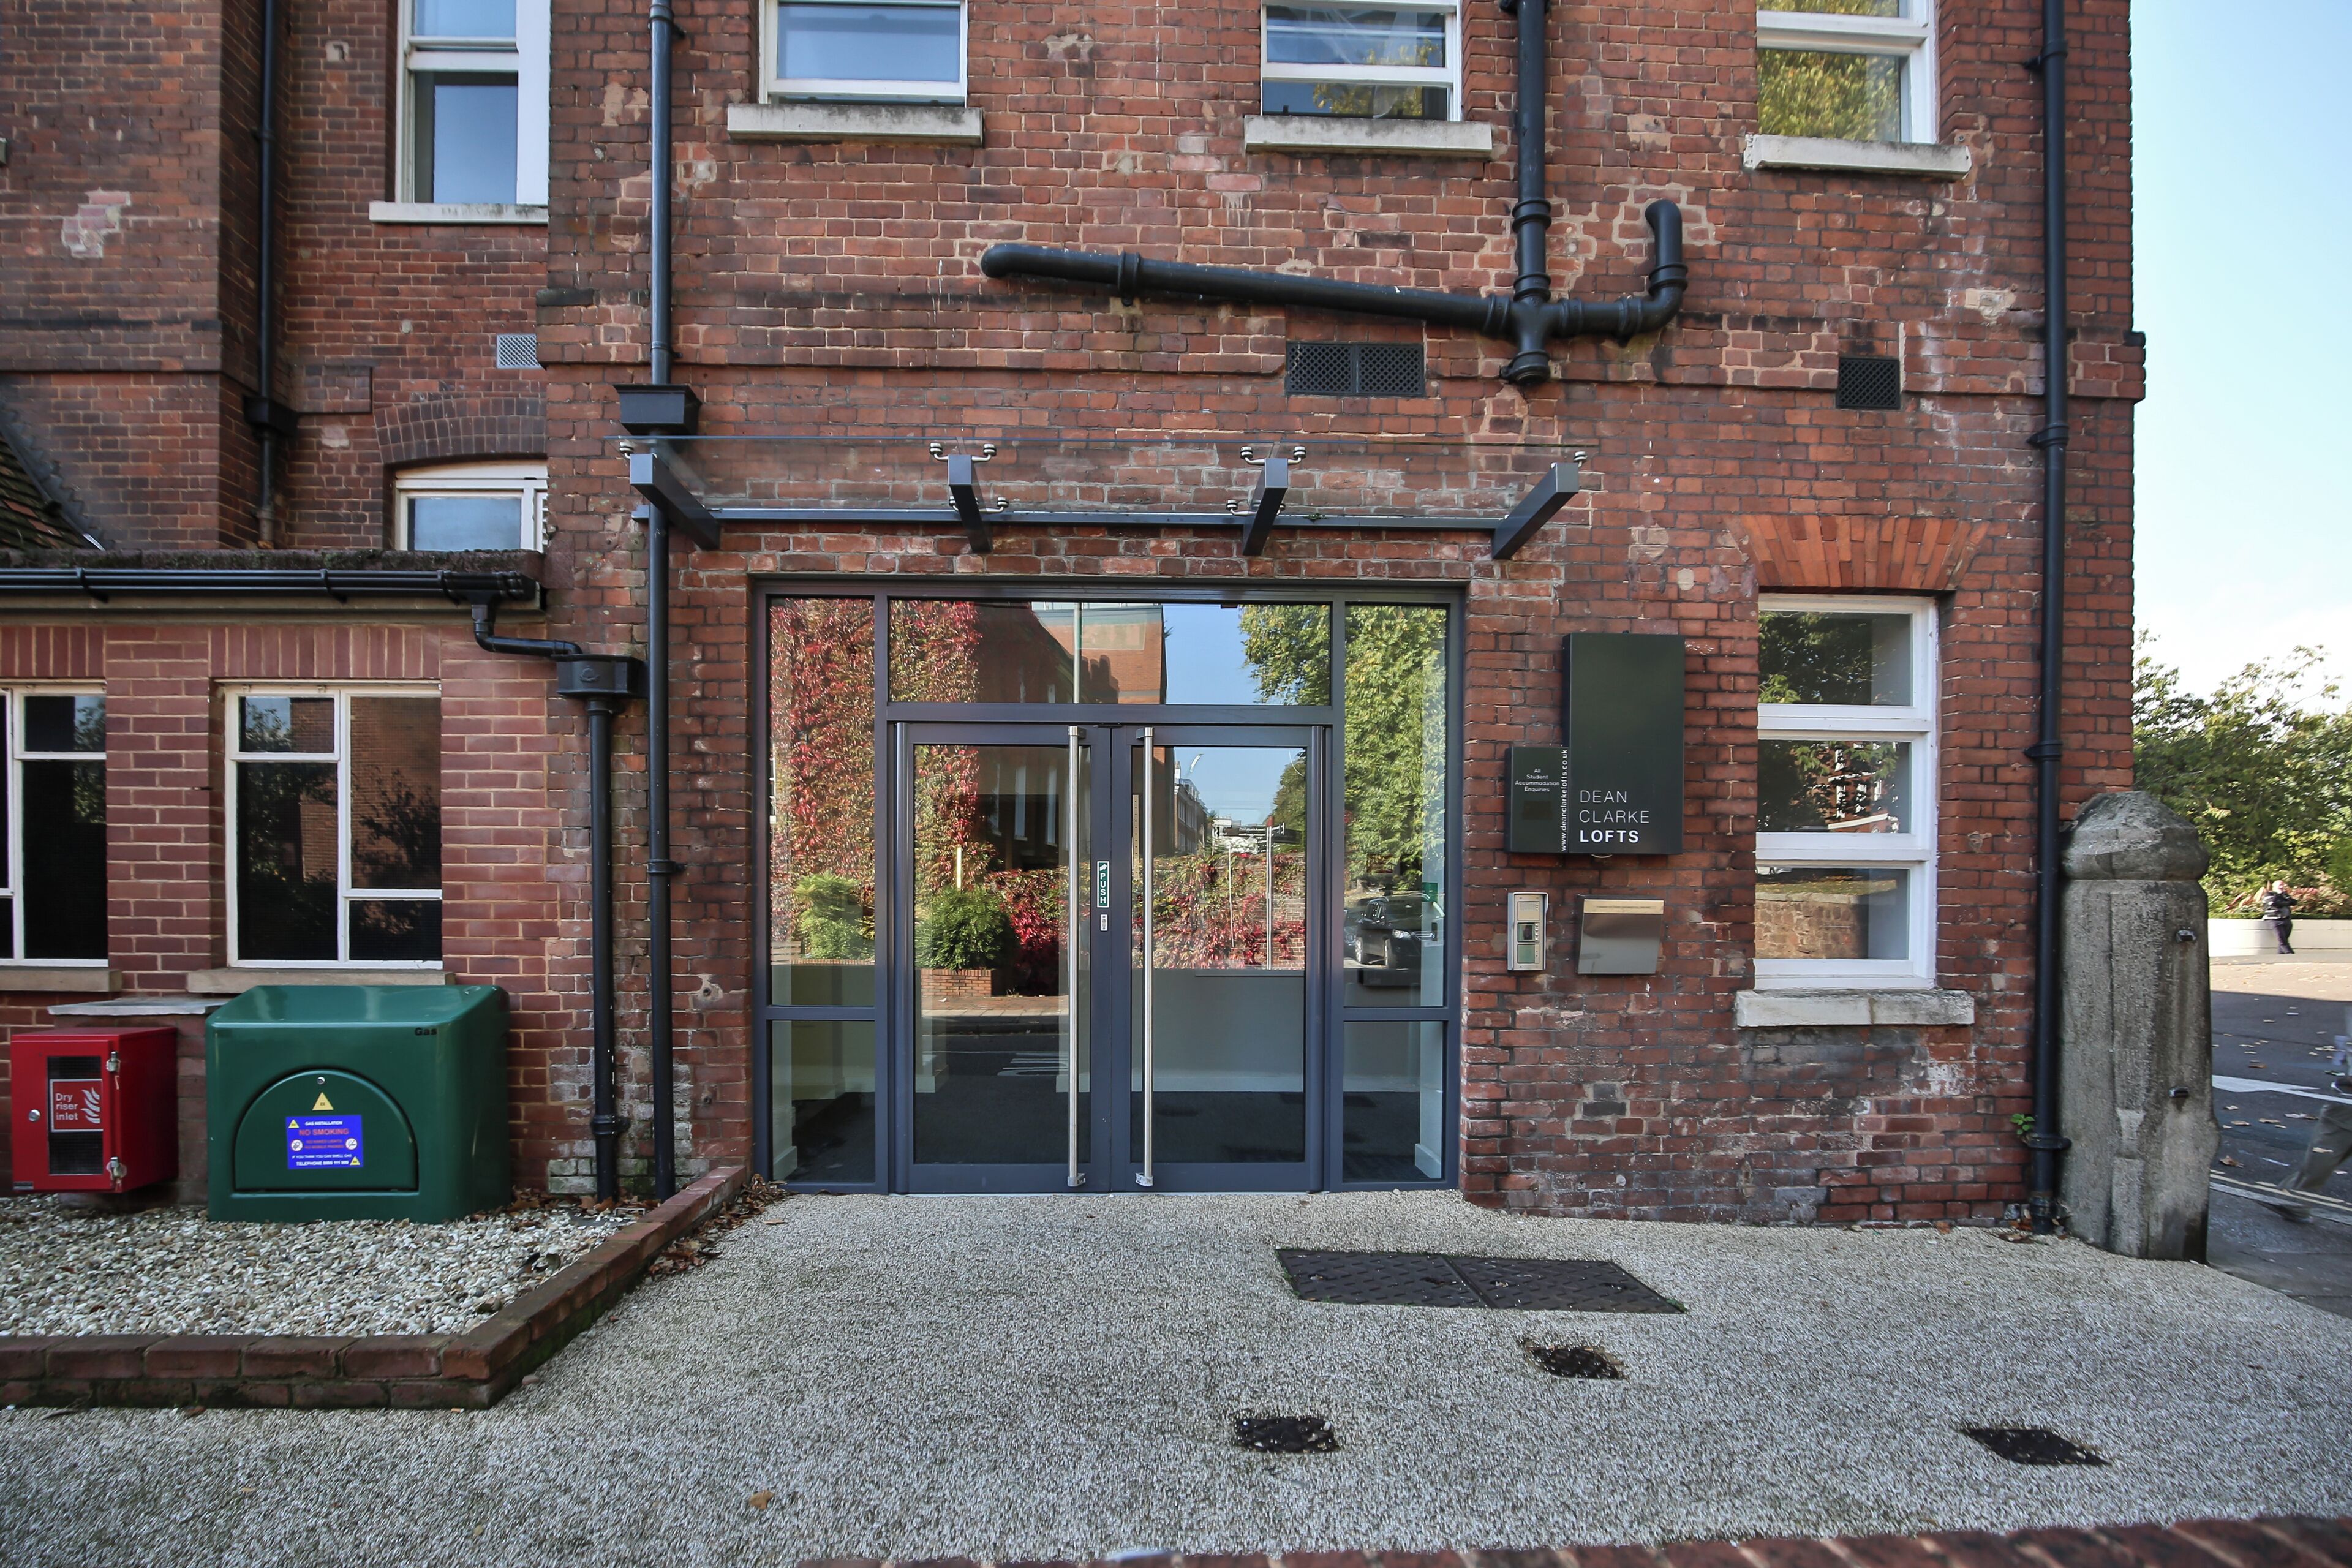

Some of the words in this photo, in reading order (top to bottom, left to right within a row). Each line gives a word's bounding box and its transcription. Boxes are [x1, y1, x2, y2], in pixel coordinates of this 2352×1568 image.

[1580, 790, 1627, 803] DEAN
[1579, 810, 1649, 823] CLARKE
[1580, 829, 1639, 843] LOFTS
[415, 1027, 437, 1036] Gas
[55, 1093, 73, 1102] Dry
[56, 1112, 78, 1121] inlet
